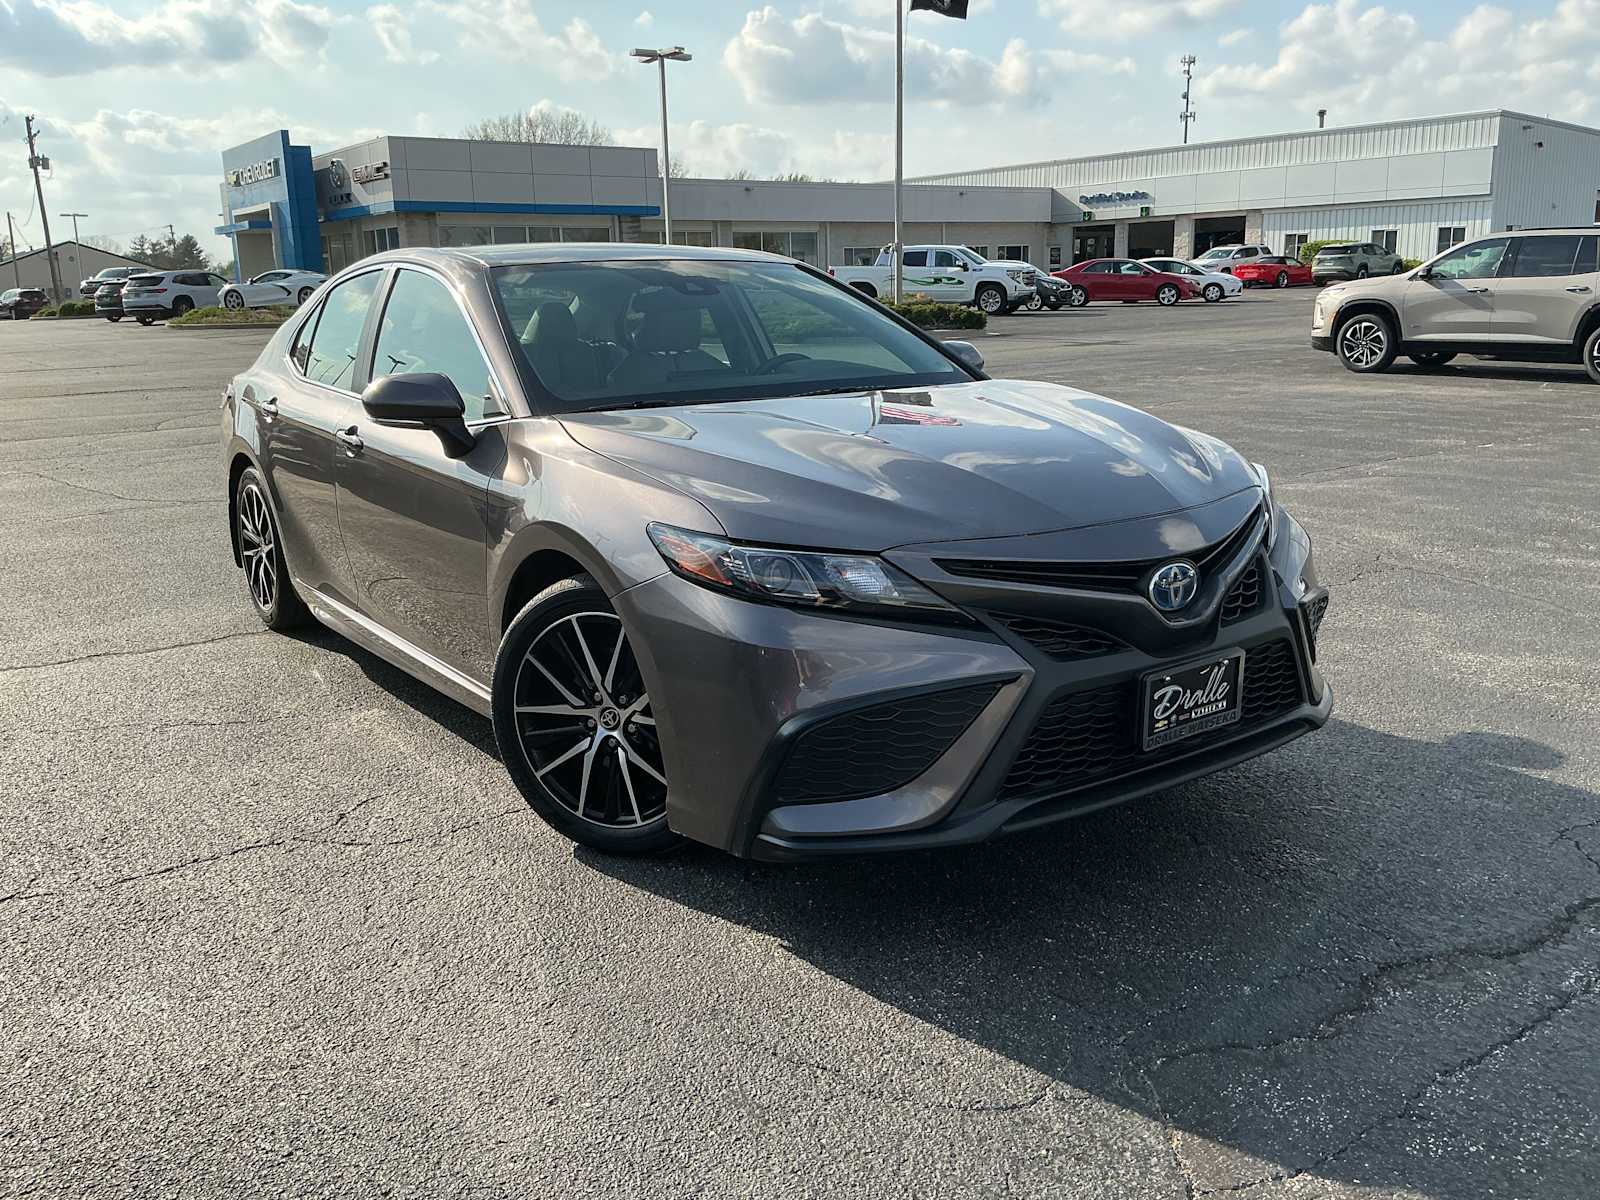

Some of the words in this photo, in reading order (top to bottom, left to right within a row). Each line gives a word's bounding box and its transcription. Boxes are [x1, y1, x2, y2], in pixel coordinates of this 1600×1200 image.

[239, 159, 276, 186] CHEVROLET
[352, 162, 388, 184] GMC
[1153, 665, 1231, 720] Dralle
